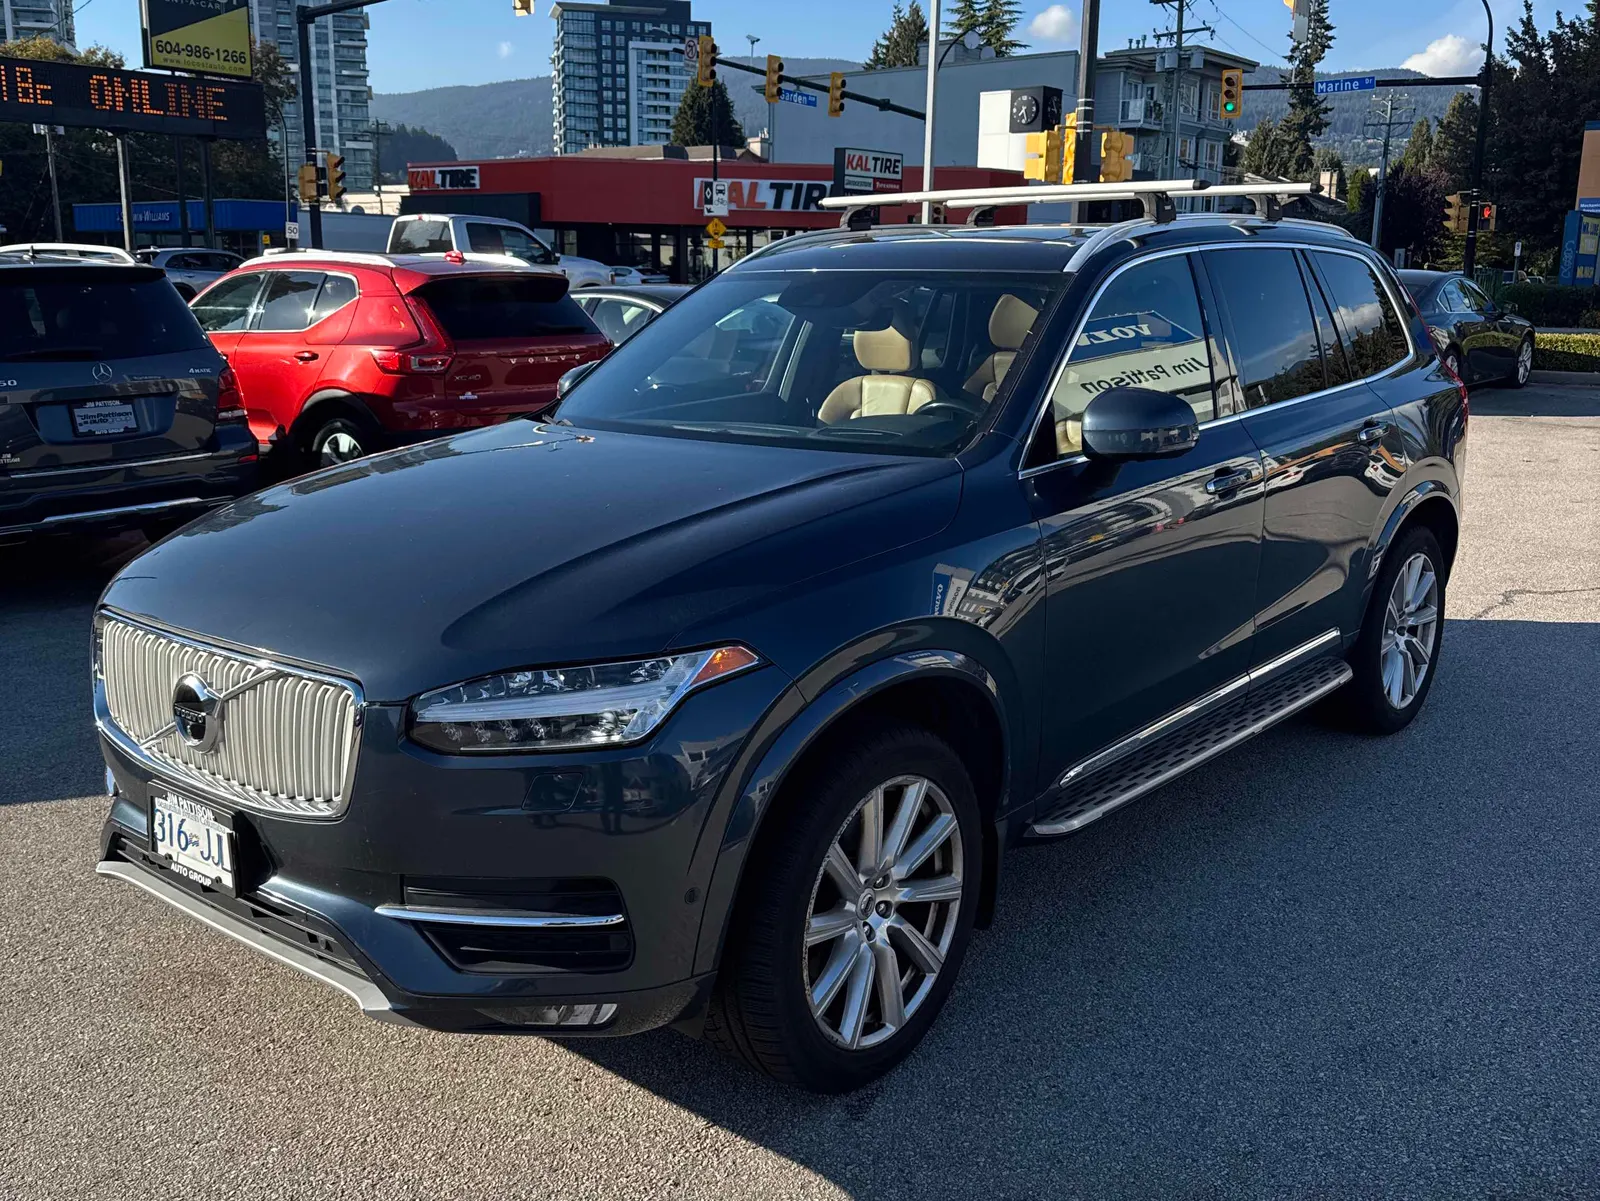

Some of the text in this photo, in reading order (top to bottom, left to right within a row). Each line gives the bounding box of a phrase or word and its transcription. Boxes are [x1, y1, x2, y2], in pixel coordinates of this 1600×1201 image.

[156, 40, 246, 64] 604-986-1266
[780, 90, 807, 104] Garden
[1318, 80, 1359, 92] Marine
[90, 75, 227, 120] ONLINE
[846, 154, 901, 175] KAL TIRE
[408, 168, 477, 189] KAL TIRE
[697, 181, 834, 211] AL TIR
[287, 226, 298, 235] 50
[509, 353, 581, 364] VOLVO
[167, 792, 180, 808] JIM
[179, 797, 214, 821] PATTISON
[154, 808, 189, 852] 316
[170, 862, 212, 887] AUTO GROUP
